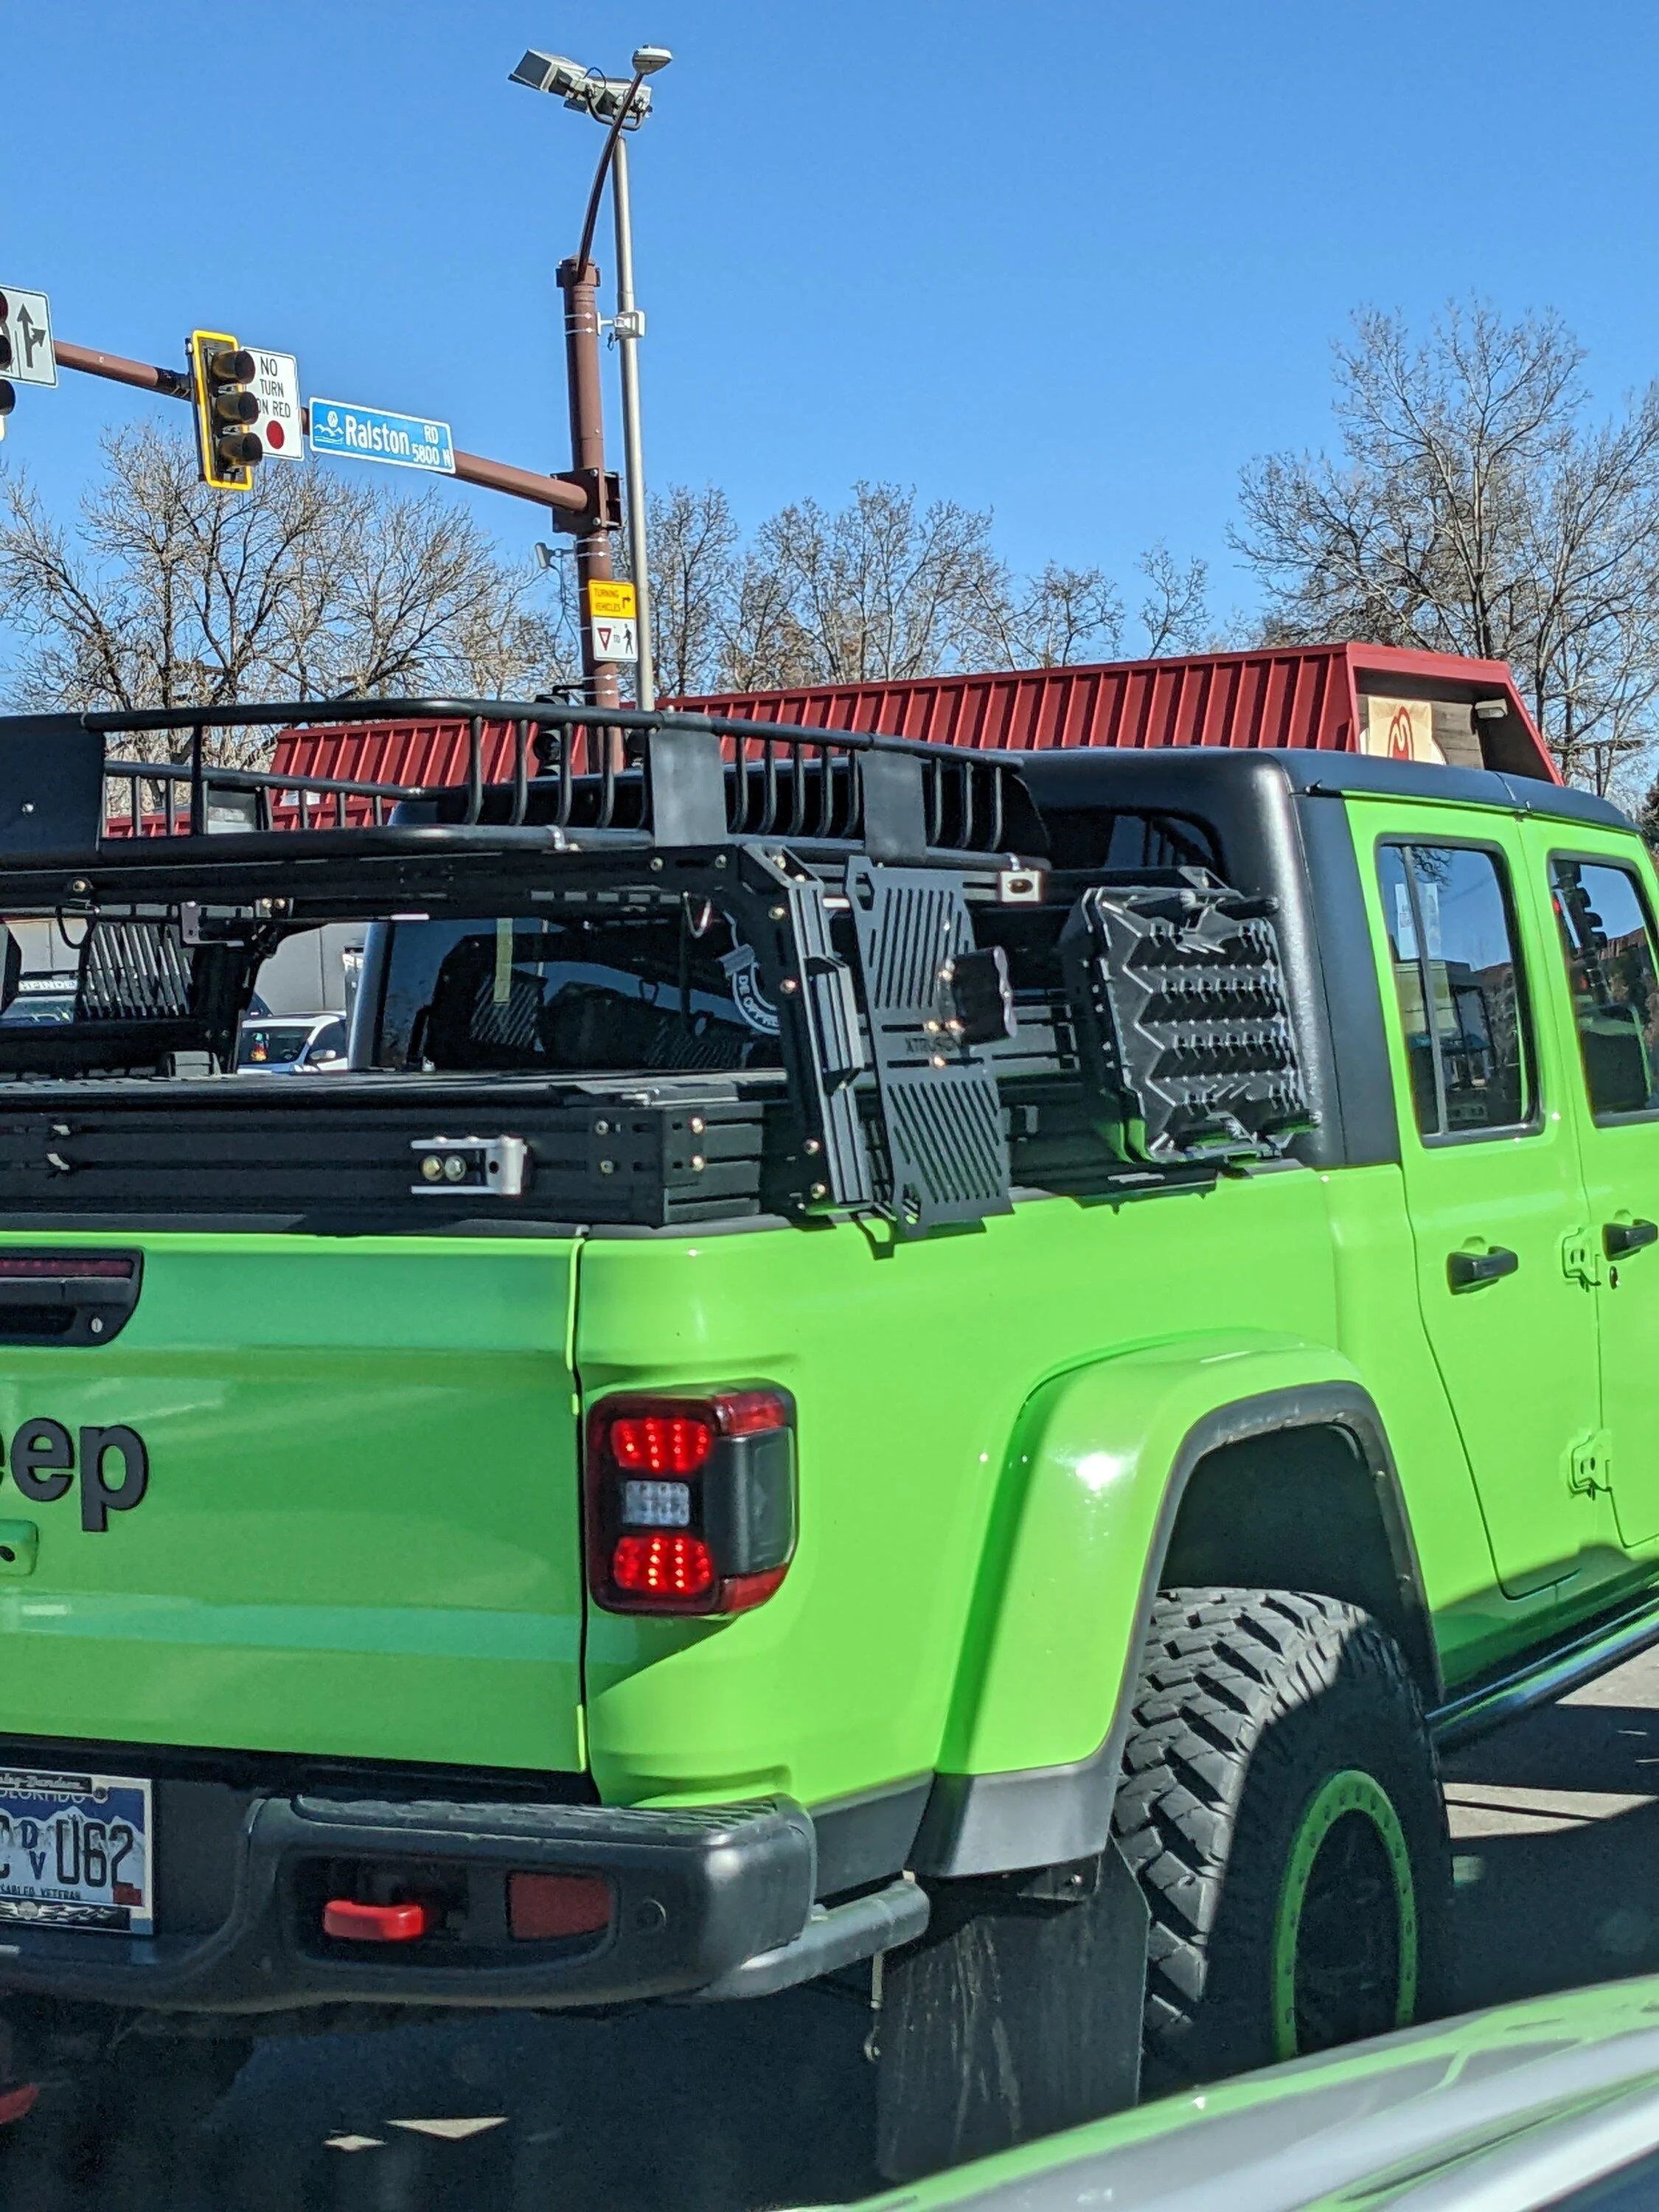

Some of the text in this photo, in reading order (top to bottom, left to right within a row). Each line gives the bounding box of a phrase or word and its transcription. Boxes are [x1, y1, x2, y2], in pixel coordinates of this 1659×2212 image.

[260, 356, 278, 377] NO
[260, 379, 285, 397] TURN
[272, 400, 291, 418] RED
[345, 414, 439, 456] Ralston RD
[411, 443, 454, 467] 5800 N
[0, 1417, 148, 1532] ep
